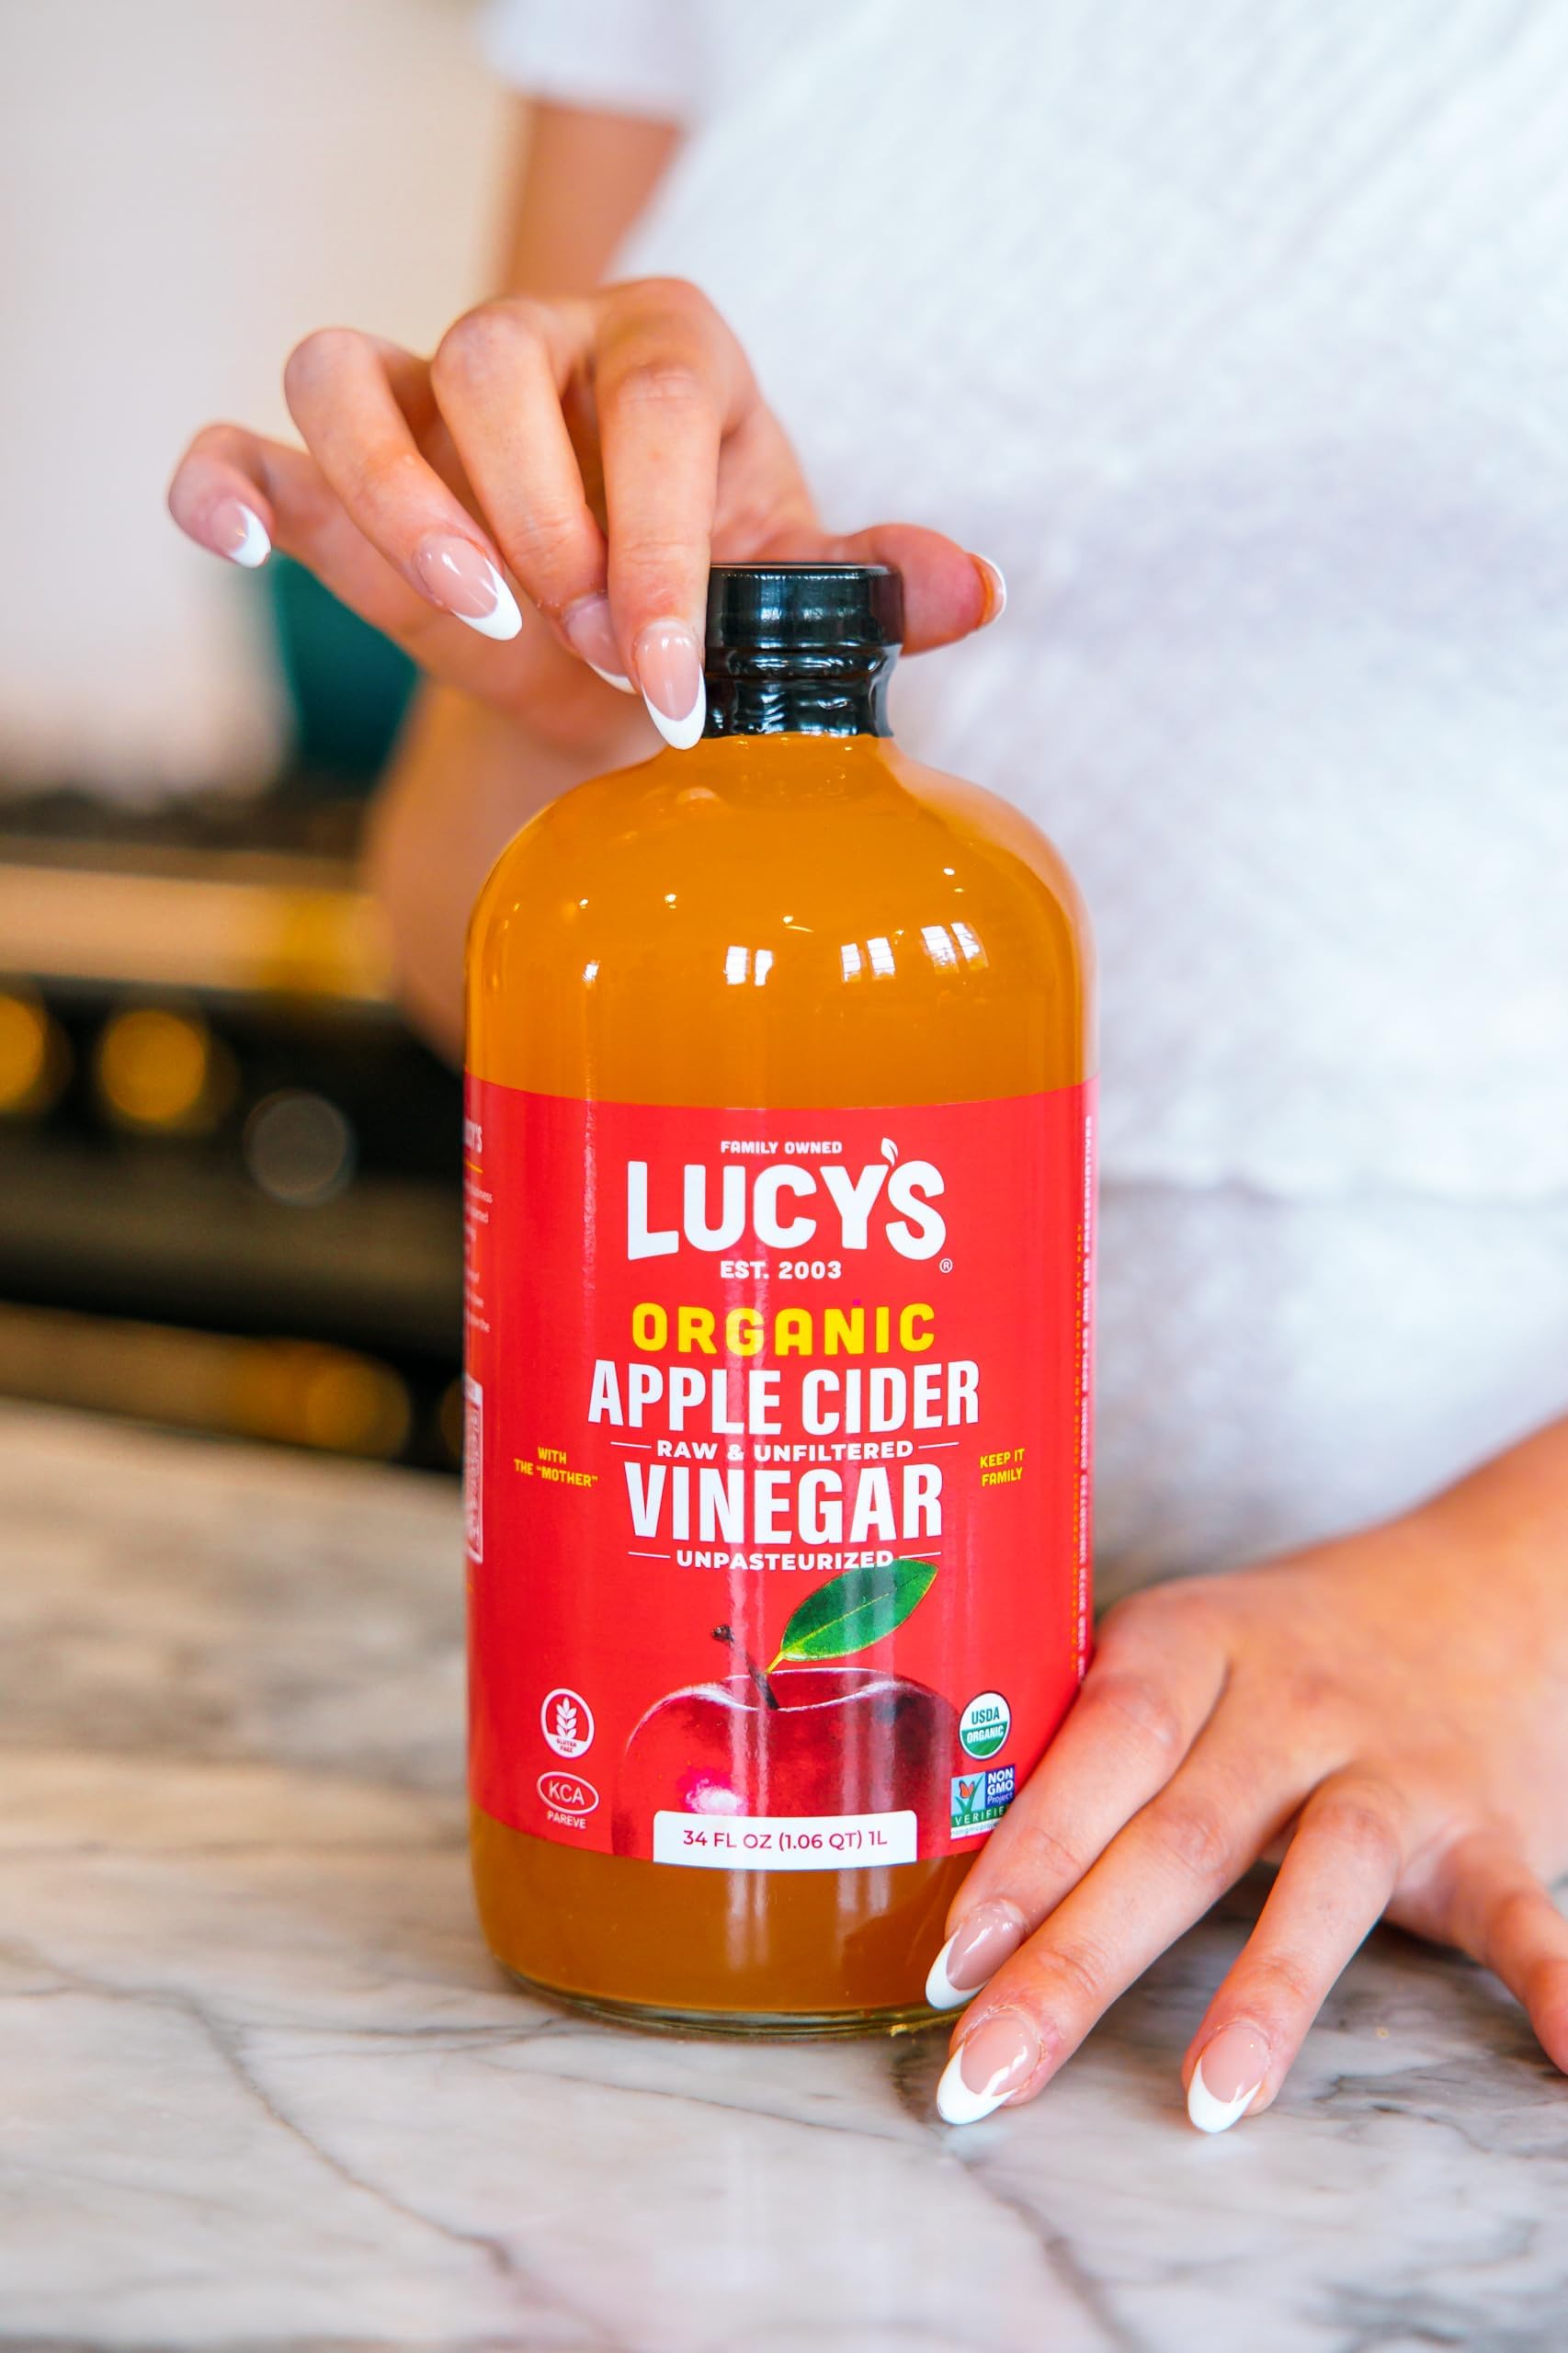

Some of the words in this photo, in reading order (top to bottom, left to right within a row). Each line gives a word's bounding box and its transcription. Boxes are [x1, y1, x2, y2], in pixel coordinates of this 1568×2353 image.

[722, 1141, 779, 1155] FAMILY
[785, 1142, 844, 1155] OWNED
[628, 1138, 946, 1260] LUCY'S
[721, 1261, 770, 1280] EST.
[778, 1261, 843, 1281] 2003
[633, 1303, 936, 1358] ORGANIC
[588, 1360, 783, 1437] APPLE
[802, 1360, 980, 1437] CIDER
[538, 1446, 566, 1464] WITH
[658, 1440, 719, 1461] RAW
[727, 1444, 745, 1463] &
[755, 1441, 915, 1463] UNFILTERED
[980, 1451, 1011, 1469] KEEP
[1015, 1448, 1026, 1462] IT
[514, 1458, 533, 1475] THE
[982, 1467, 1023, 1487] FAMILY
[625, 1461, 943, 1545] VINEGAR
[676, 1550, 893, 1570] UNPASTEURIZED
[971, 1706, 1000, 1725] USDA
[967, 1725, 1005, 1744] ORGANIC
[987, 1768, 1014, 1784] NON
[549, 1779, 585, 1805] KCA
[987, 1780, 1014, 1796] GMO
[547, 1810, 586, 1829] PAREVE
[955, 1805, 1005, 1826] VERIFIE
[683, 1830, 708, 1847] 34
[713, 1832, 737, 1848] FL
[743, 1834, 772, 1849] OZ
[778, 1832, 823, 1852] (1.06
[828, 1830, 863, 1850] QT)
[869, 1830, 888, 1846] 1L
